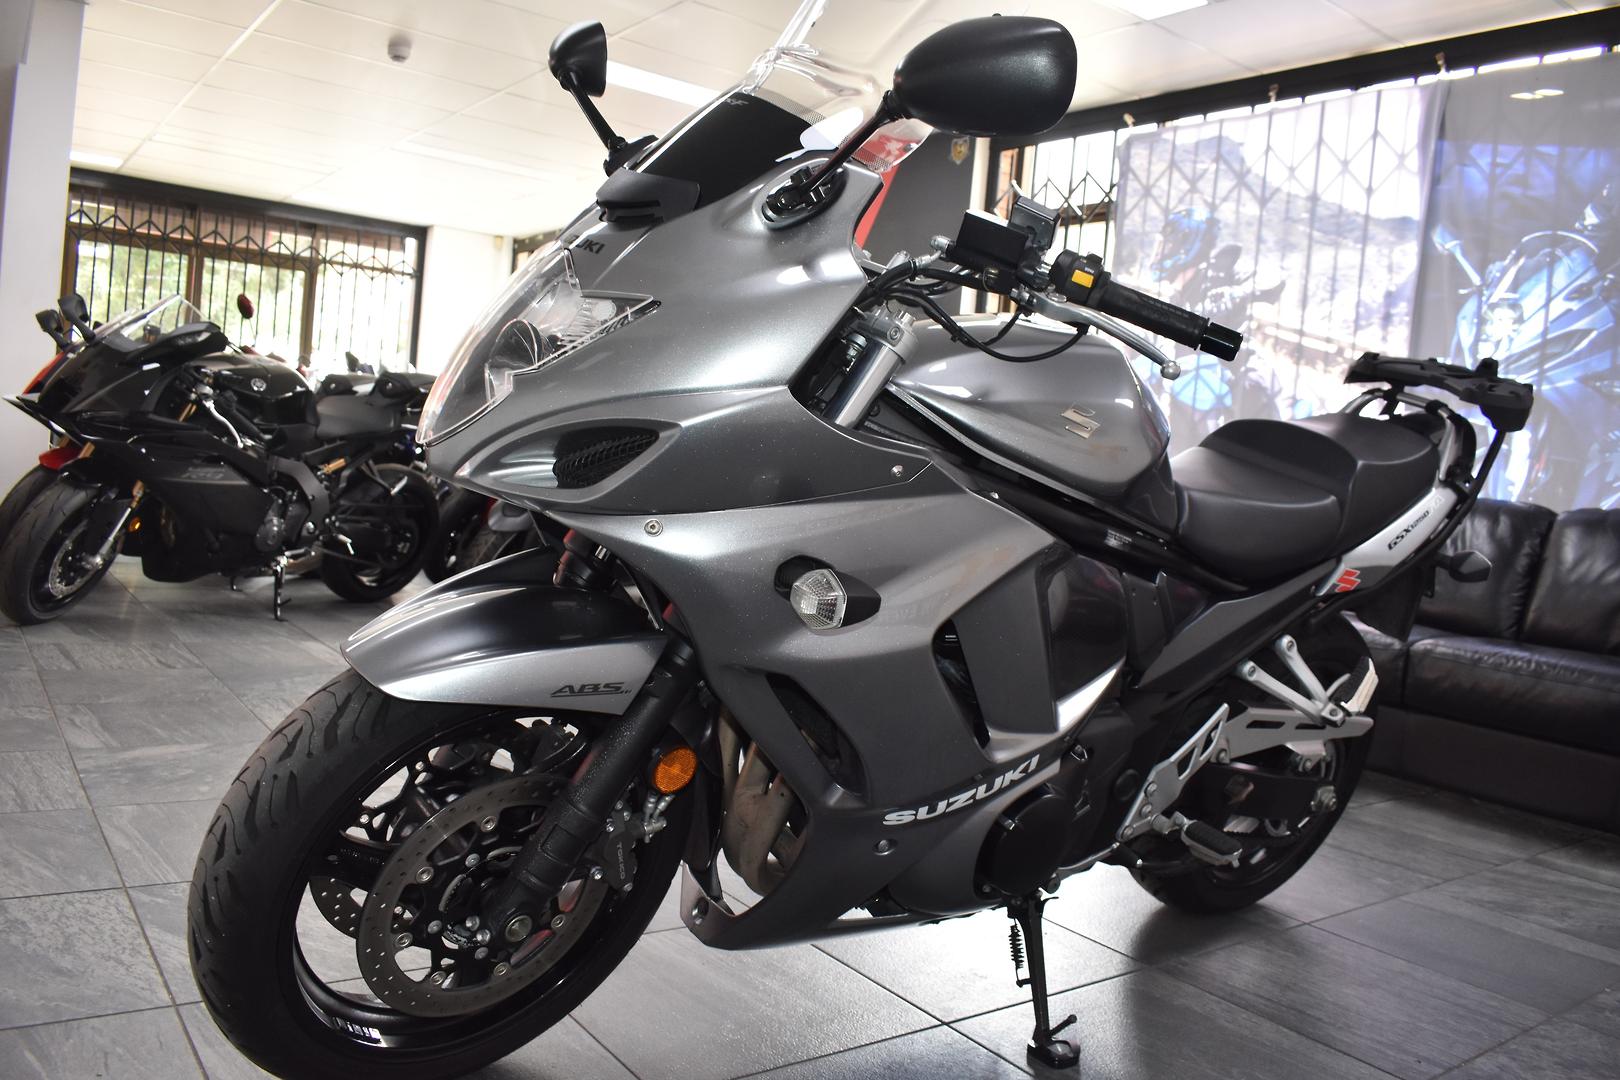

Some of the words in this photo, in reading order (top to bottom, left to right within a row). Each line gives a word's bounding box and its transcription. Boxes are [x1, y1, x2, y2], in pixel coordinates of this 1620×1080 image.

[574, 237, 606, 254] UKI
[551, 681, 625, 695] ABS
[882, 753, 1041, 826] SUZUKI
